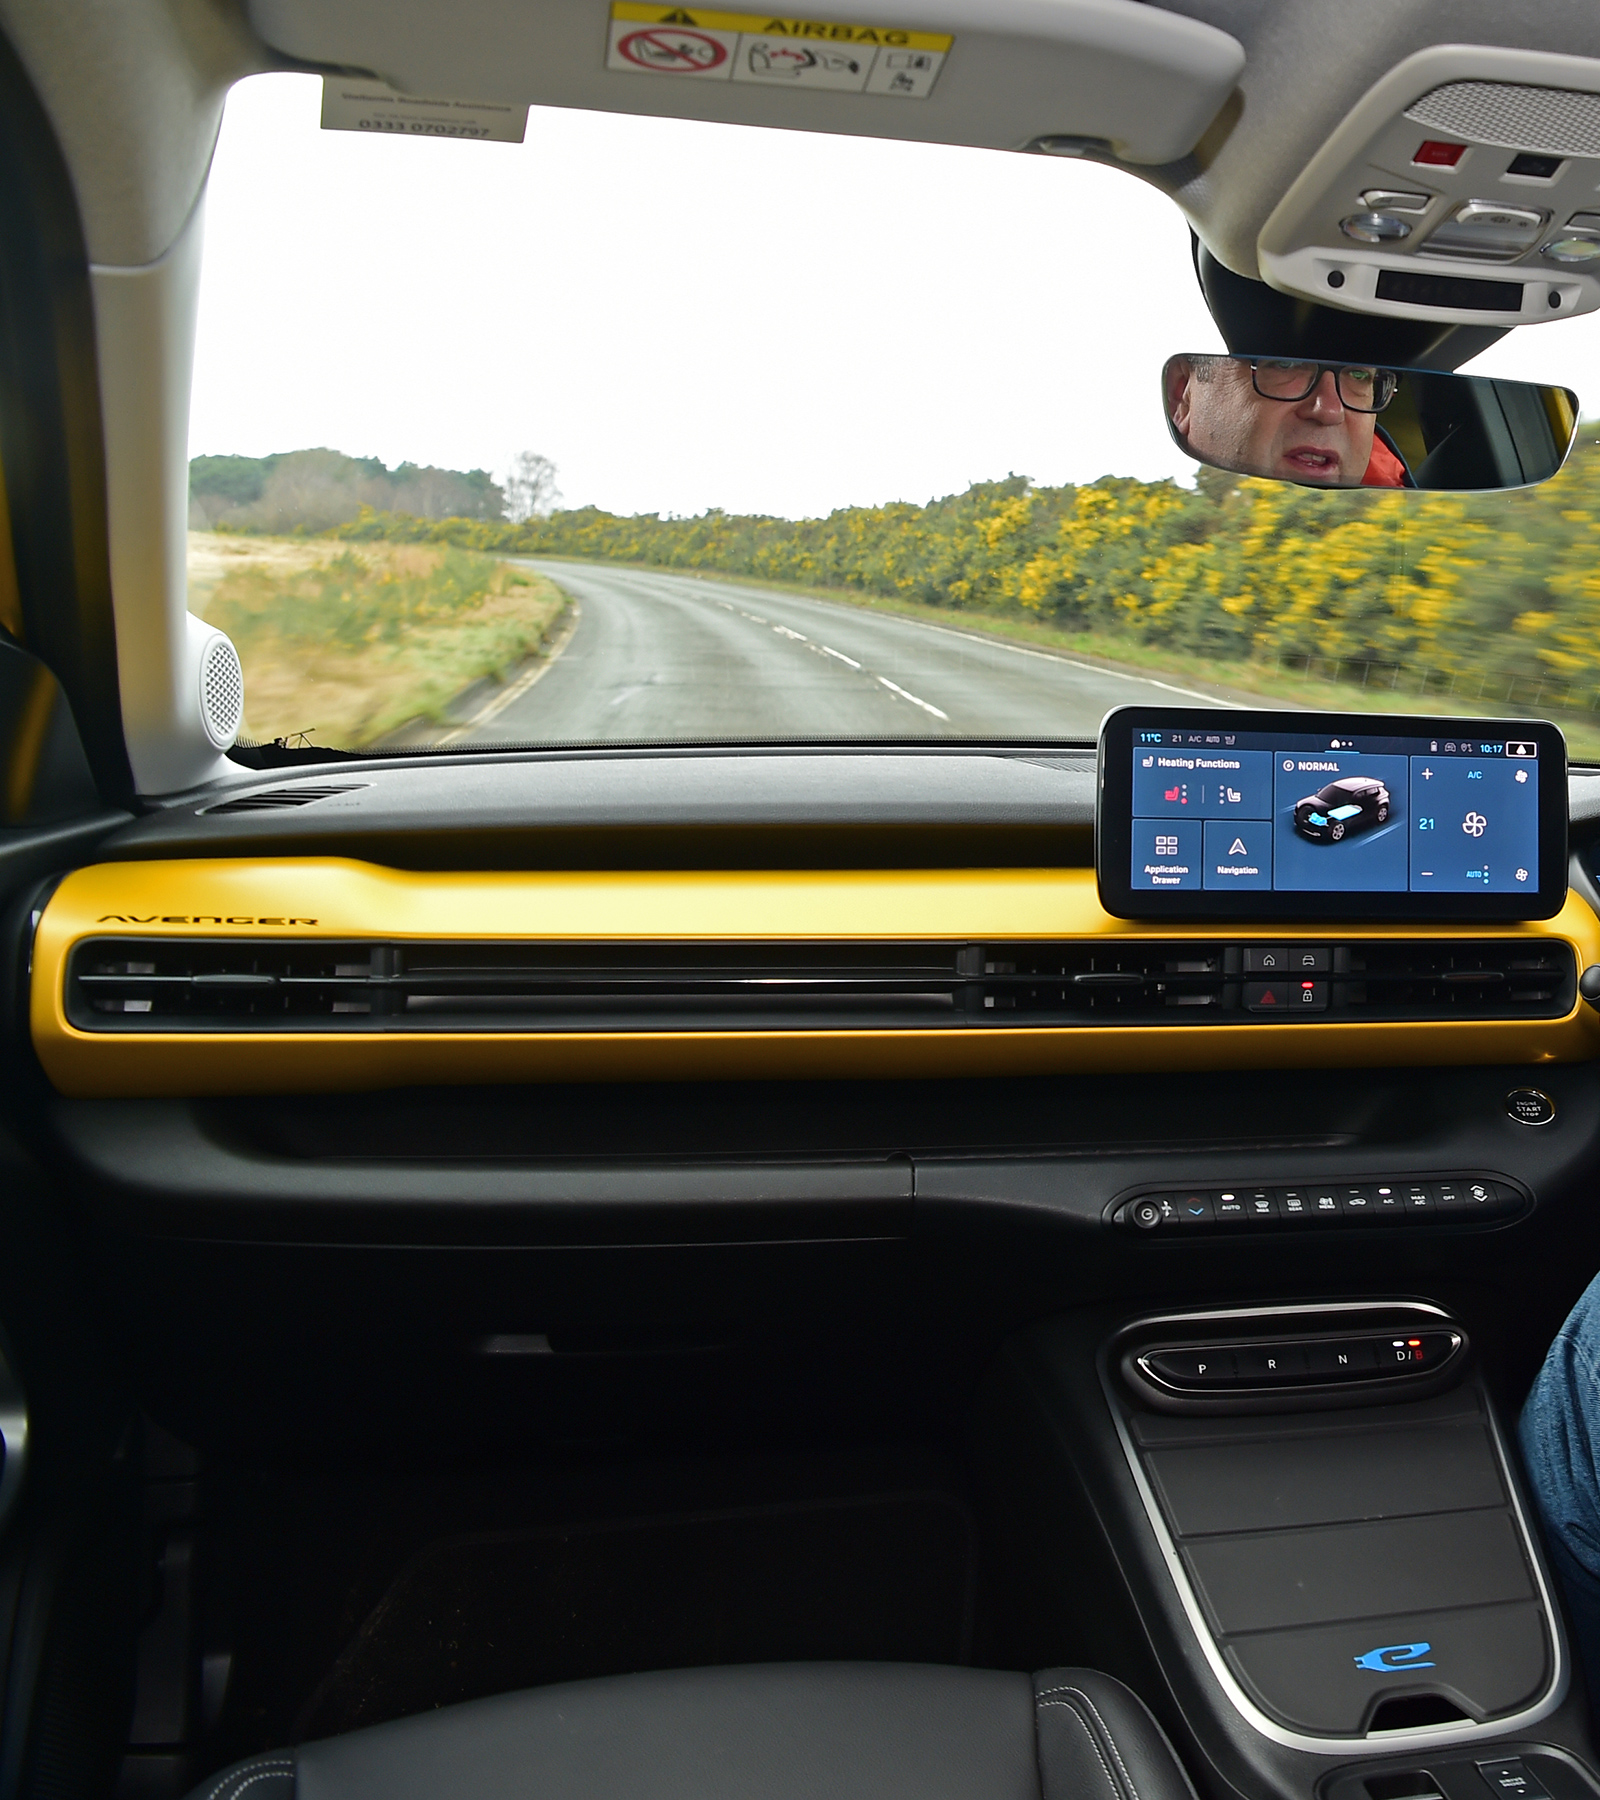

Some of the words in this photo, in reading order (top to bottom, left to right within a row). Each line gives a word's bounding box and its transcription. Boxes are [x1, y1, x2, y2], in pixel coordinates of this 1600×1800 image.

[763, 19, 909, 45] AIRBAG
[358, 119, 406, 131] 0333
[410, 122, 491, 137] 0702797
[1140, 733, 1162, 743] 11°C
[1171, 734, 1182, 743] 21
[1187, 735, 1202, 743] A/C
[1205, 735, 1220, 744] AUTO
[1479, 744, 1504, 754] 10:17
[1157, 757, 1194, 770] Heating
[1195, 757, 1241, 769] Functions
[1298, 761, 1340, 772] NORMAL
[1467, 770, 1483, 779] A/C
[1418, 817, 1435, 830] 21
[1144, 864, 1189, 875] Application
[1216, 865, 1259, 876] Navigation
[1465, 870, 1482, 878] AUTO
[1151, 875, 1181, 885] Drawer
[96, 914, 319, 926] AVENGER
[1267, 1359, 1277, 1369] R
[1338, 1354, 1348, 1365] N
[1198, 1364, 1207, 1374] P
